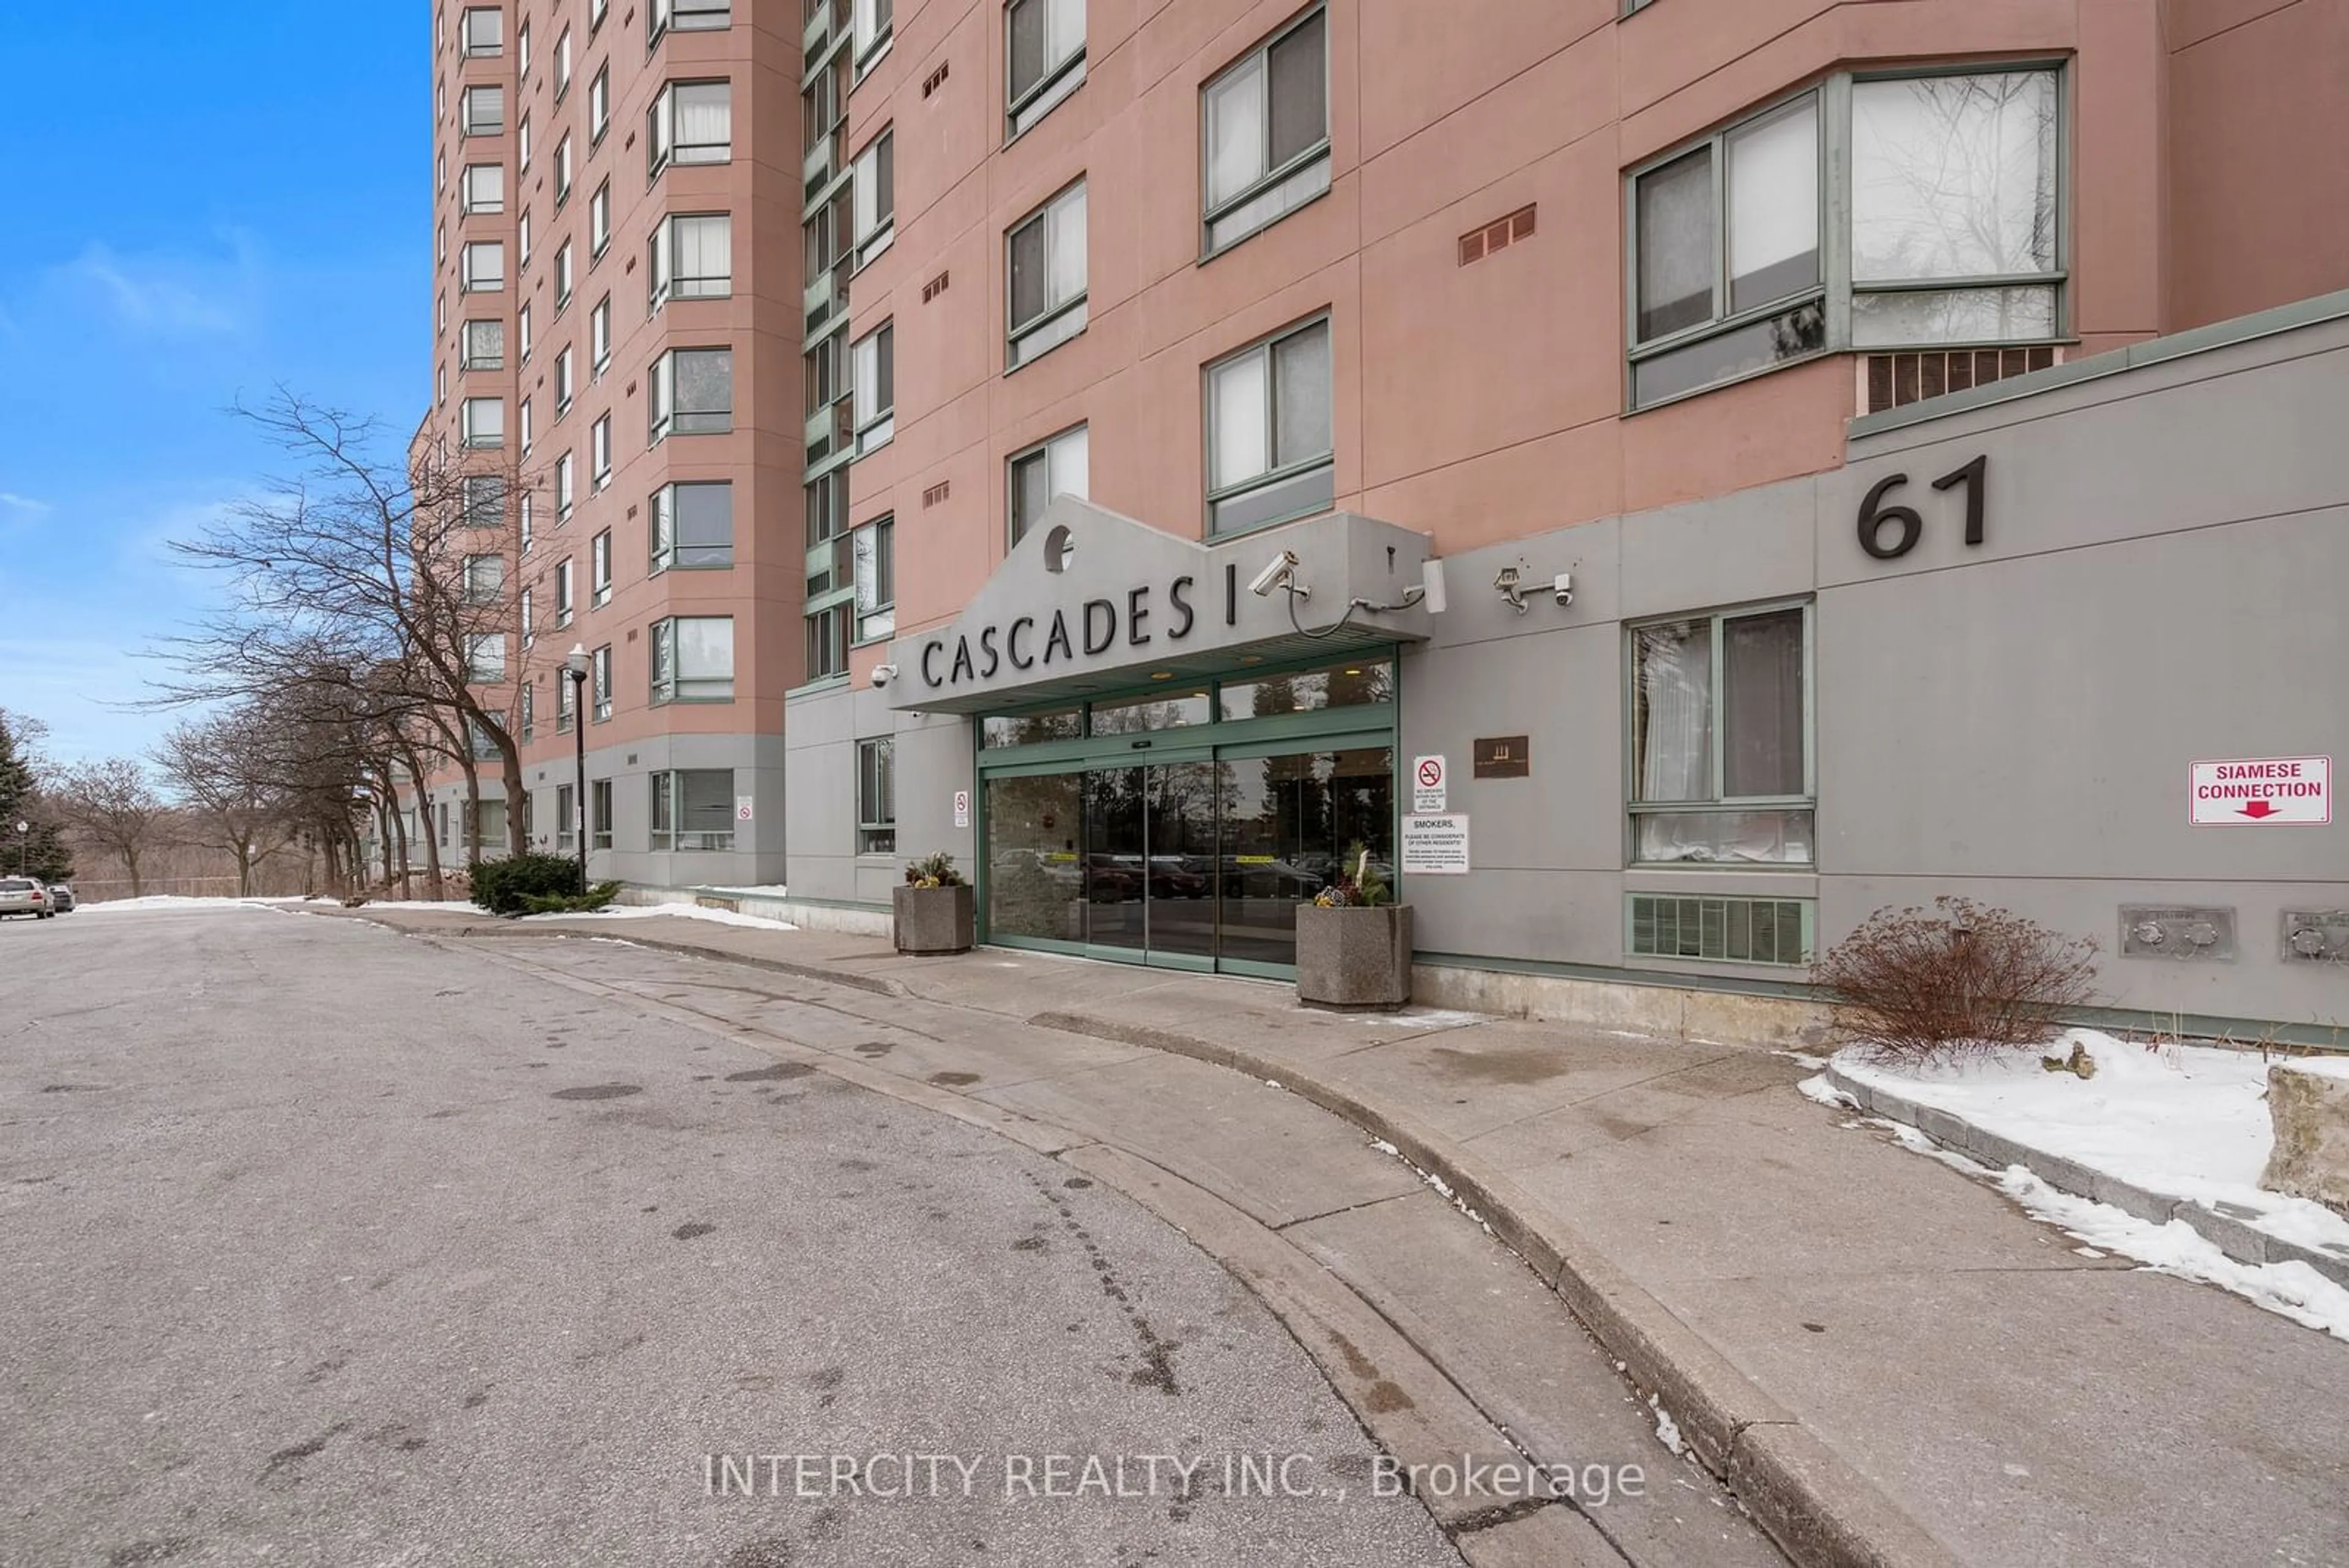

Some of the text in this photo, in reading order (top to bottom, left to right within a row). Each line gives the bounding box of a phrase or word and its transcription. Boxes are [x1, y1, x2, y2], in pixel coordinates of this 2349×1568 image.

[1857, 455, 1987, 559] 61
[921, 563, 1236, 688] CASCADES I
[2216, 764, 2301, 780] SIAMESE
[2198, 782, 2321, 799] CONNECTION
[1414, 819, 1456, 829] SMOKERS,
